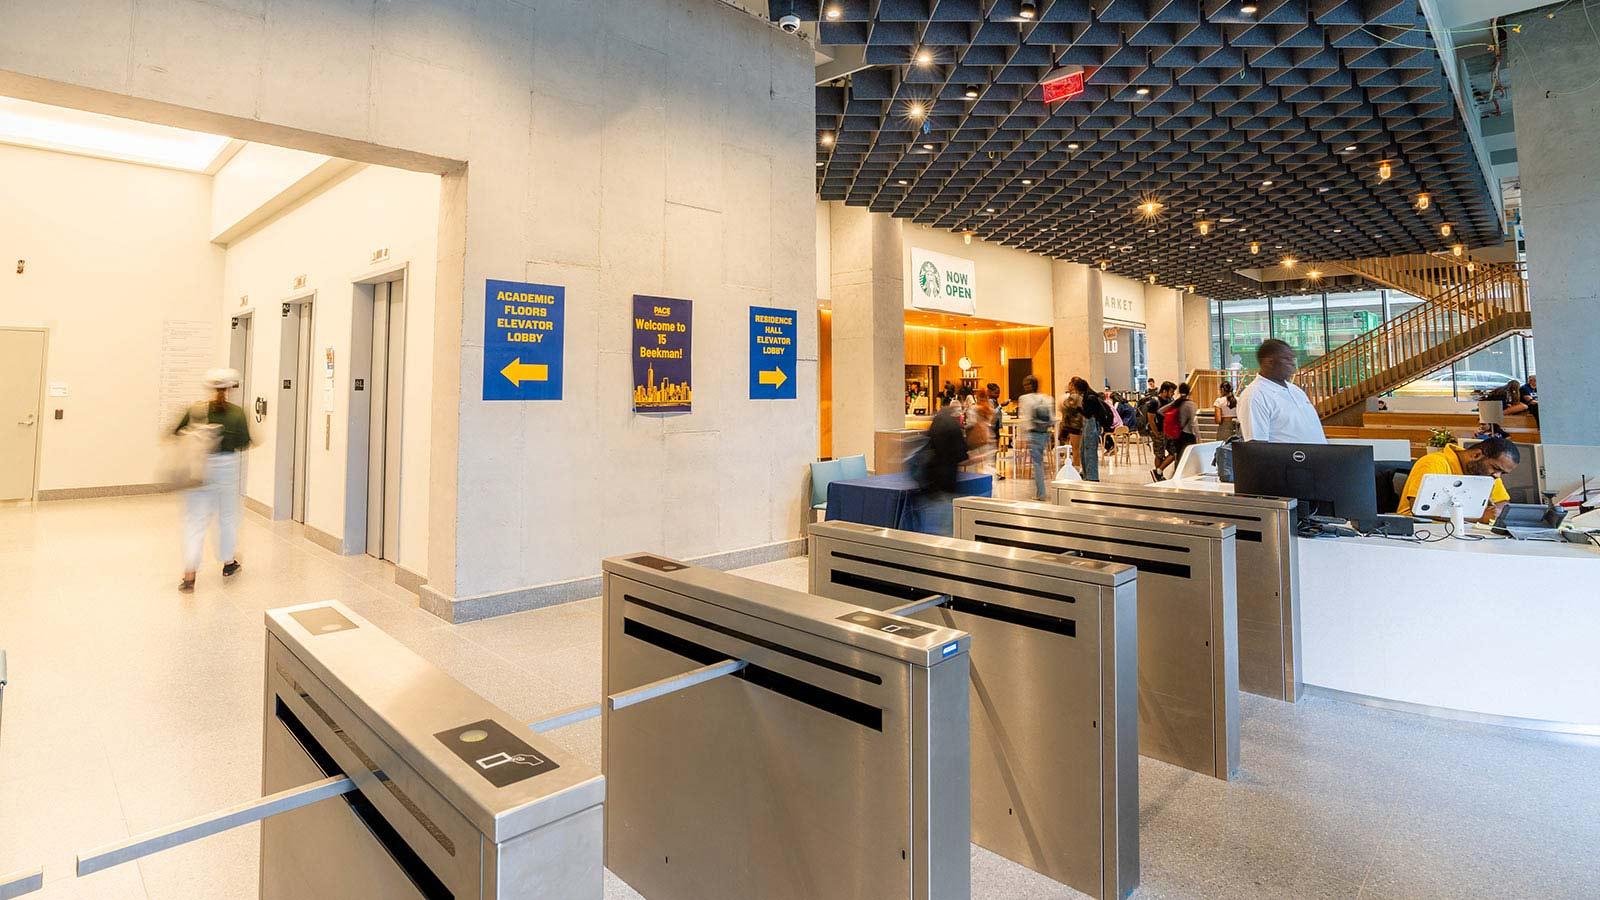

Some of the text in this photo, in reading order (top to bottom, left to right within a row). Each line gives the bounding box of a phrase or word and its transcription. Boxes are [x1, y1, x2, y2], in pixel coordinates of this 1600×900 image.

[946, 270, 968, 285] NOW
[945, 284, 972, 299] OPEN
[497, 291, 555, 305] ACADEMIC
[504, 305, 547, 317] FLOORS
[653, 306, 671, 315] PACE
[497, 318, 553, 331] ELEVATOR
[635, 318, 686, 332] Welcome to
[755, 314, 792, 325] RESIDENCE
[765, 326, 783, 335] HALL
[507, 332, 544, 343] LOBBY
[657, 333, 667, 345] 15
[756, 336, 791, 345] ELEVATOR
[640, 346, 683, 359] Beekman!
[762, 346, 785, 355] LOBBY
